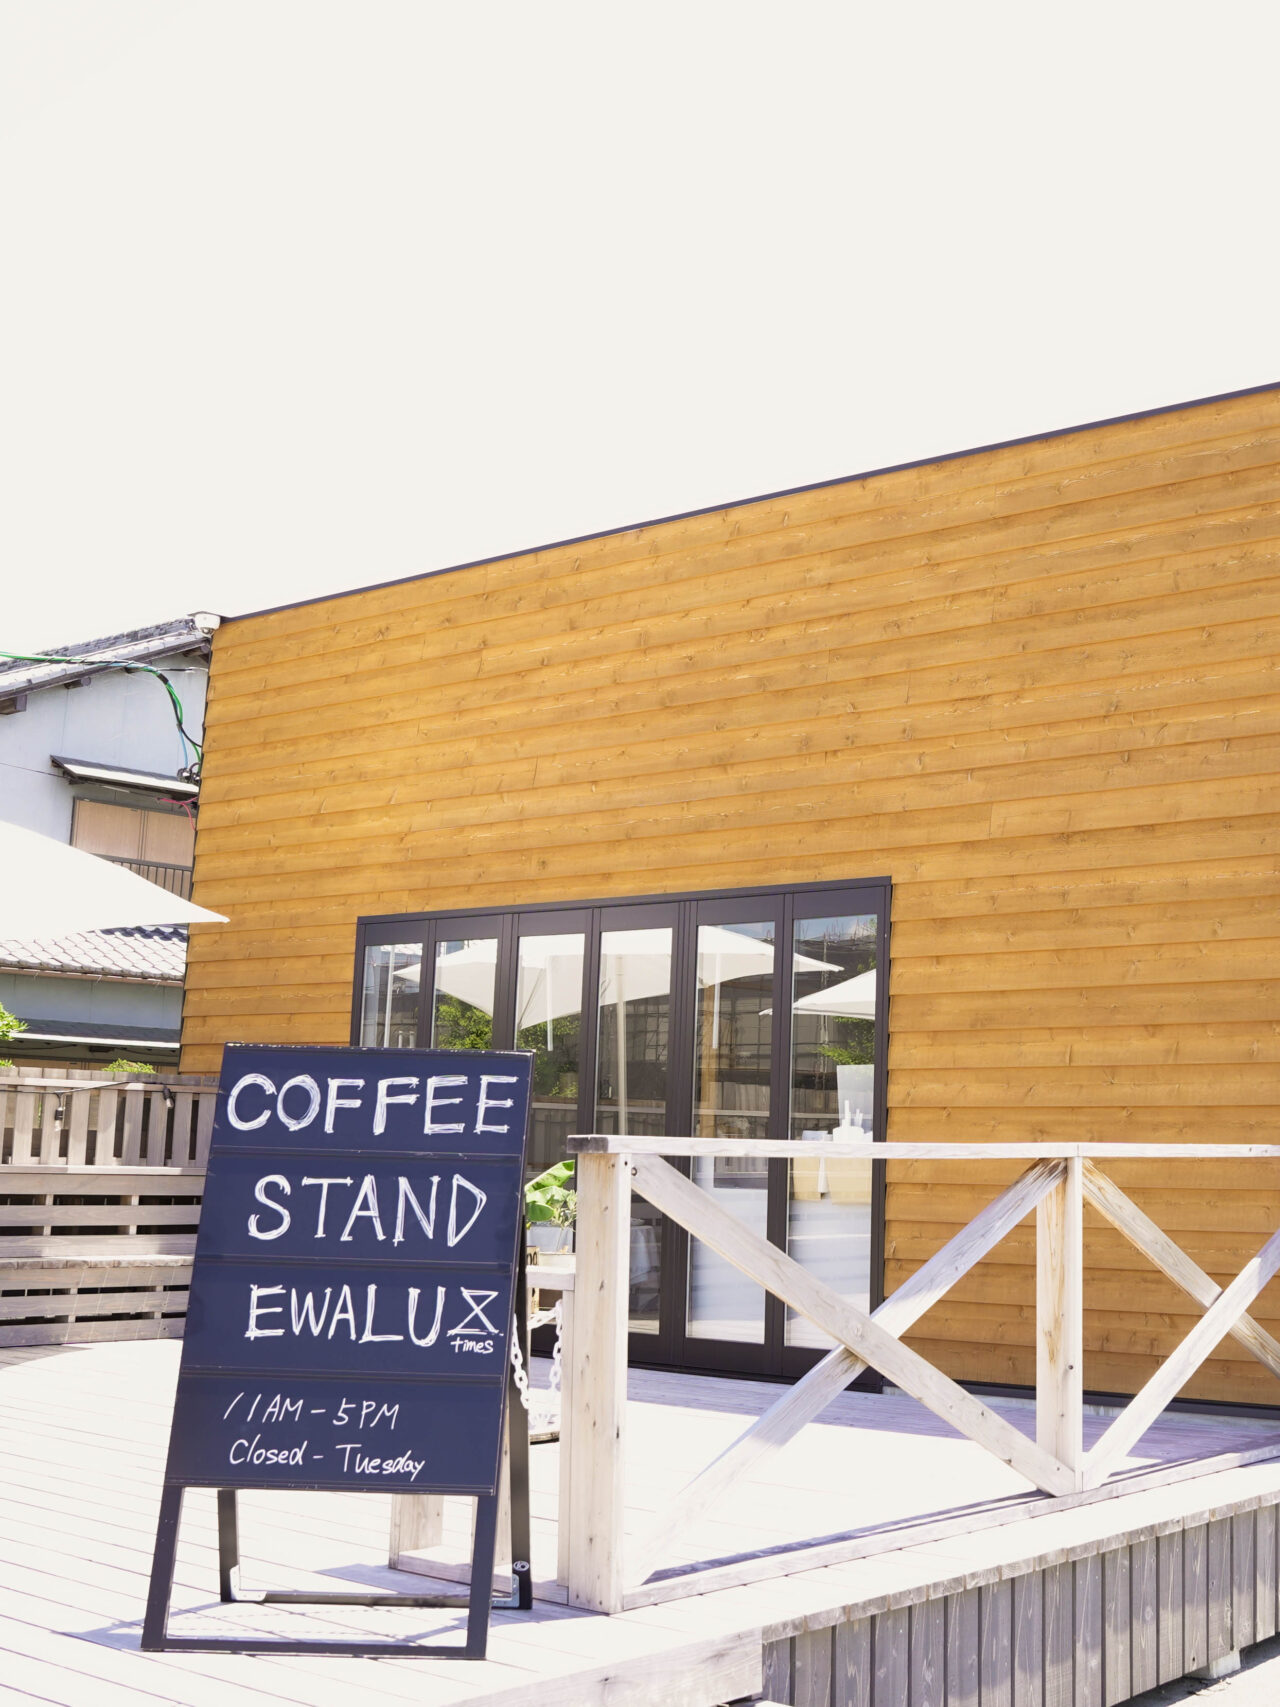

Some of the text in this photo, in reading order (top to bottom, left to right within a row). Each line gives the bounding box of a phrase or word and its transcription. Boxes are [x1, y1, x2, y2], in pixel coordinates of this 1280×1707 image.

[227, 1073, 519, 1136] COFFEE
[248, 1173, 488, 1247] STAND
[450, 1336, 494, 1355] times
[229, 1433, 307, 1466] Closed
[335, 1443, 426, 1482] Tuesday
